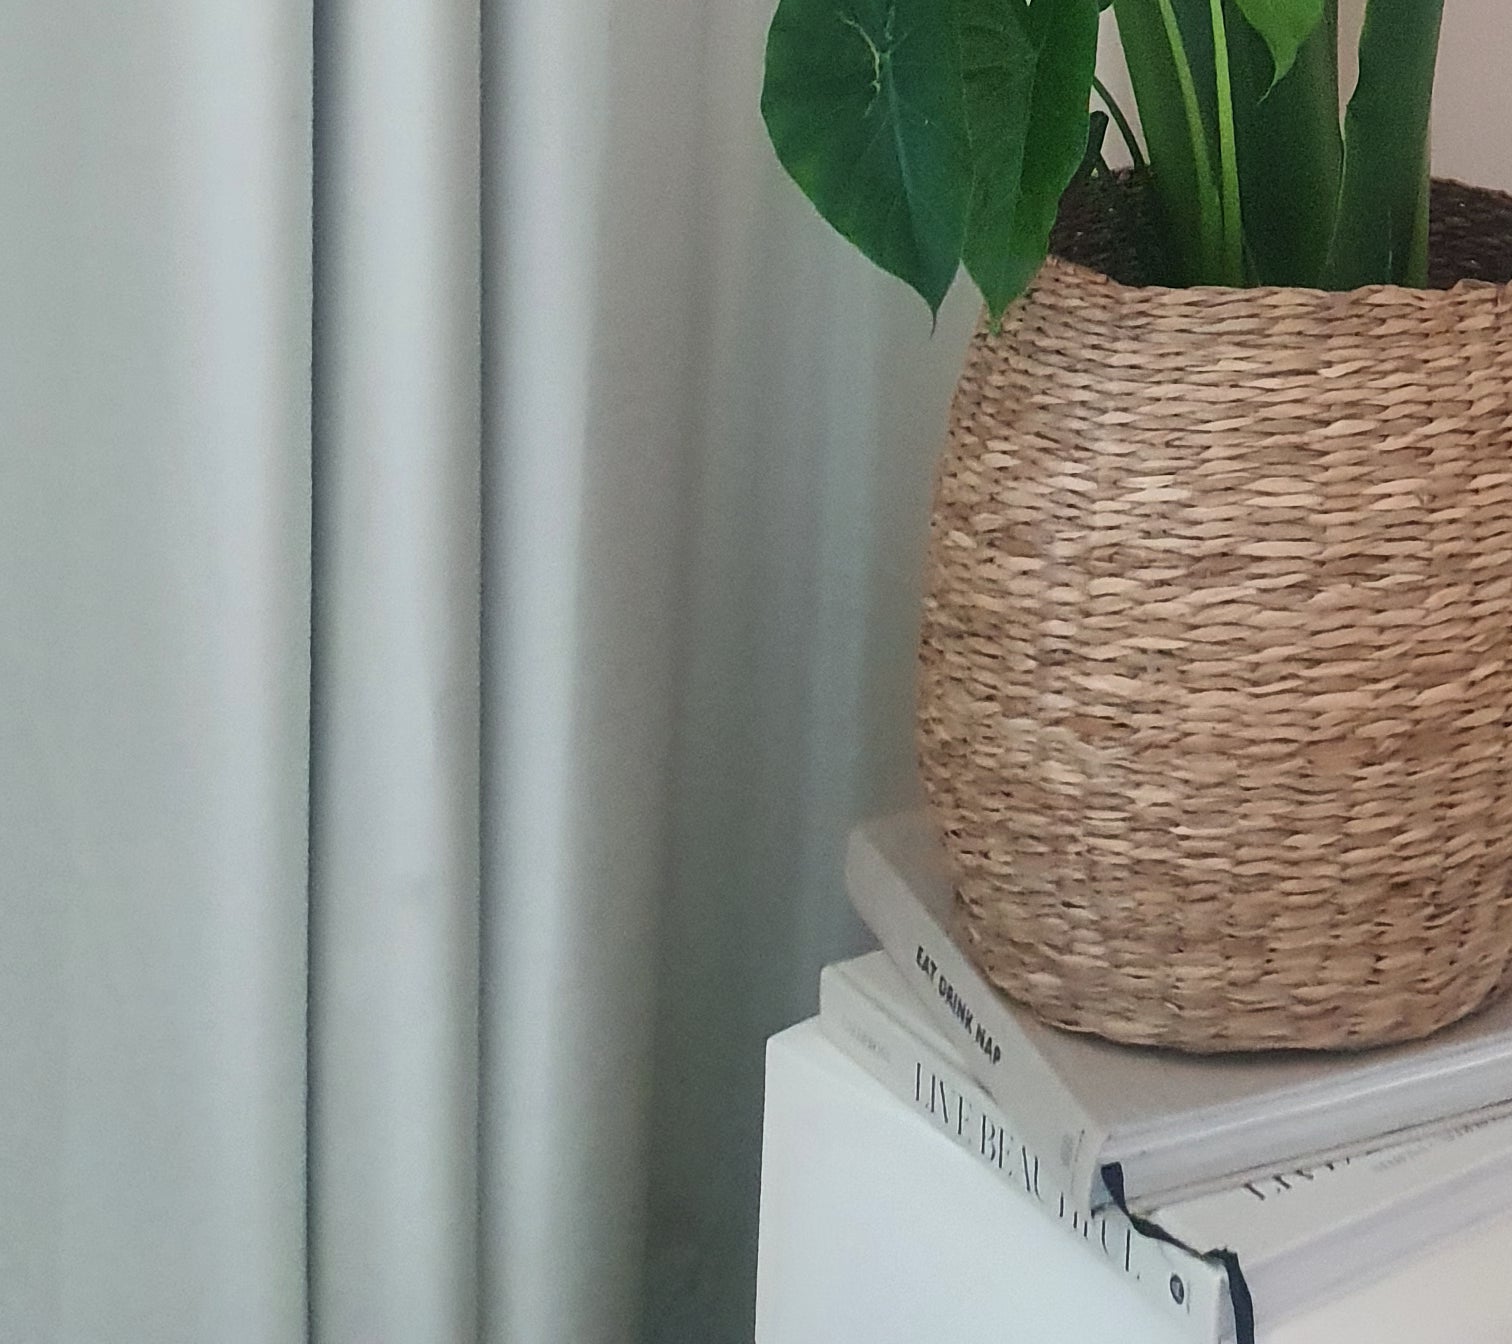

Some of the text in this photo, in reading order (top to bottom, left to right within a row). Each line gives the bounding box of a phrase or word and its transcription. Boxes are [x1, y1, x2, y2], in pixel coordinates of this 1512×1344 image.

[916, 945, 1002, 1065] EAT DRINK NAP
